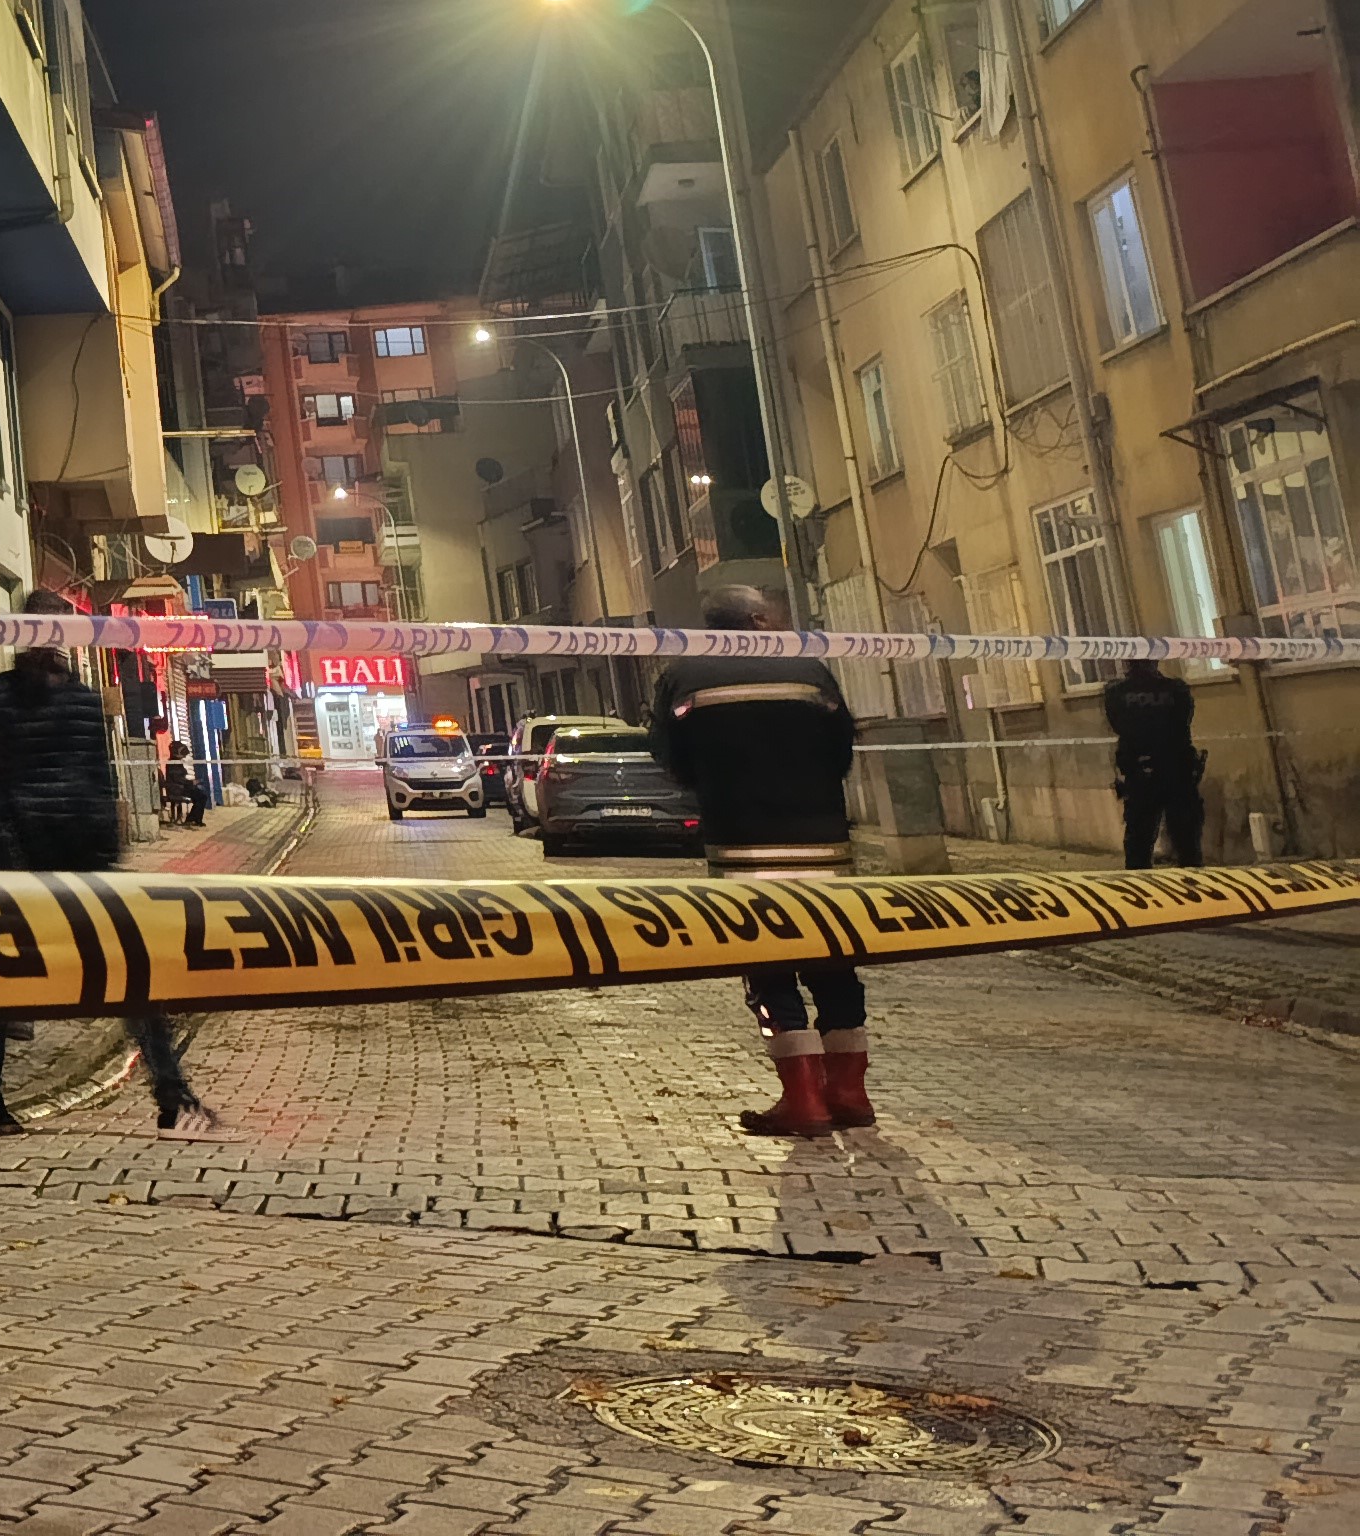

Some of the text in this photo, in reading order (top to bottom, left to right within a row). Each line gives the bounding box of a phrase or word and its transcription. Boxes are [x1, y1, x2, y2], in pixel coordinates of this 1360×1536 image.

[166, 622, 283, 650] ZABITA
[370, 627, 472, 653] ZABITA
[544, 630, 638, 655] ZABITA
[140, 885, 534, 971] GİRİLMEZ
[596, 883, 805, 948] POLİS
